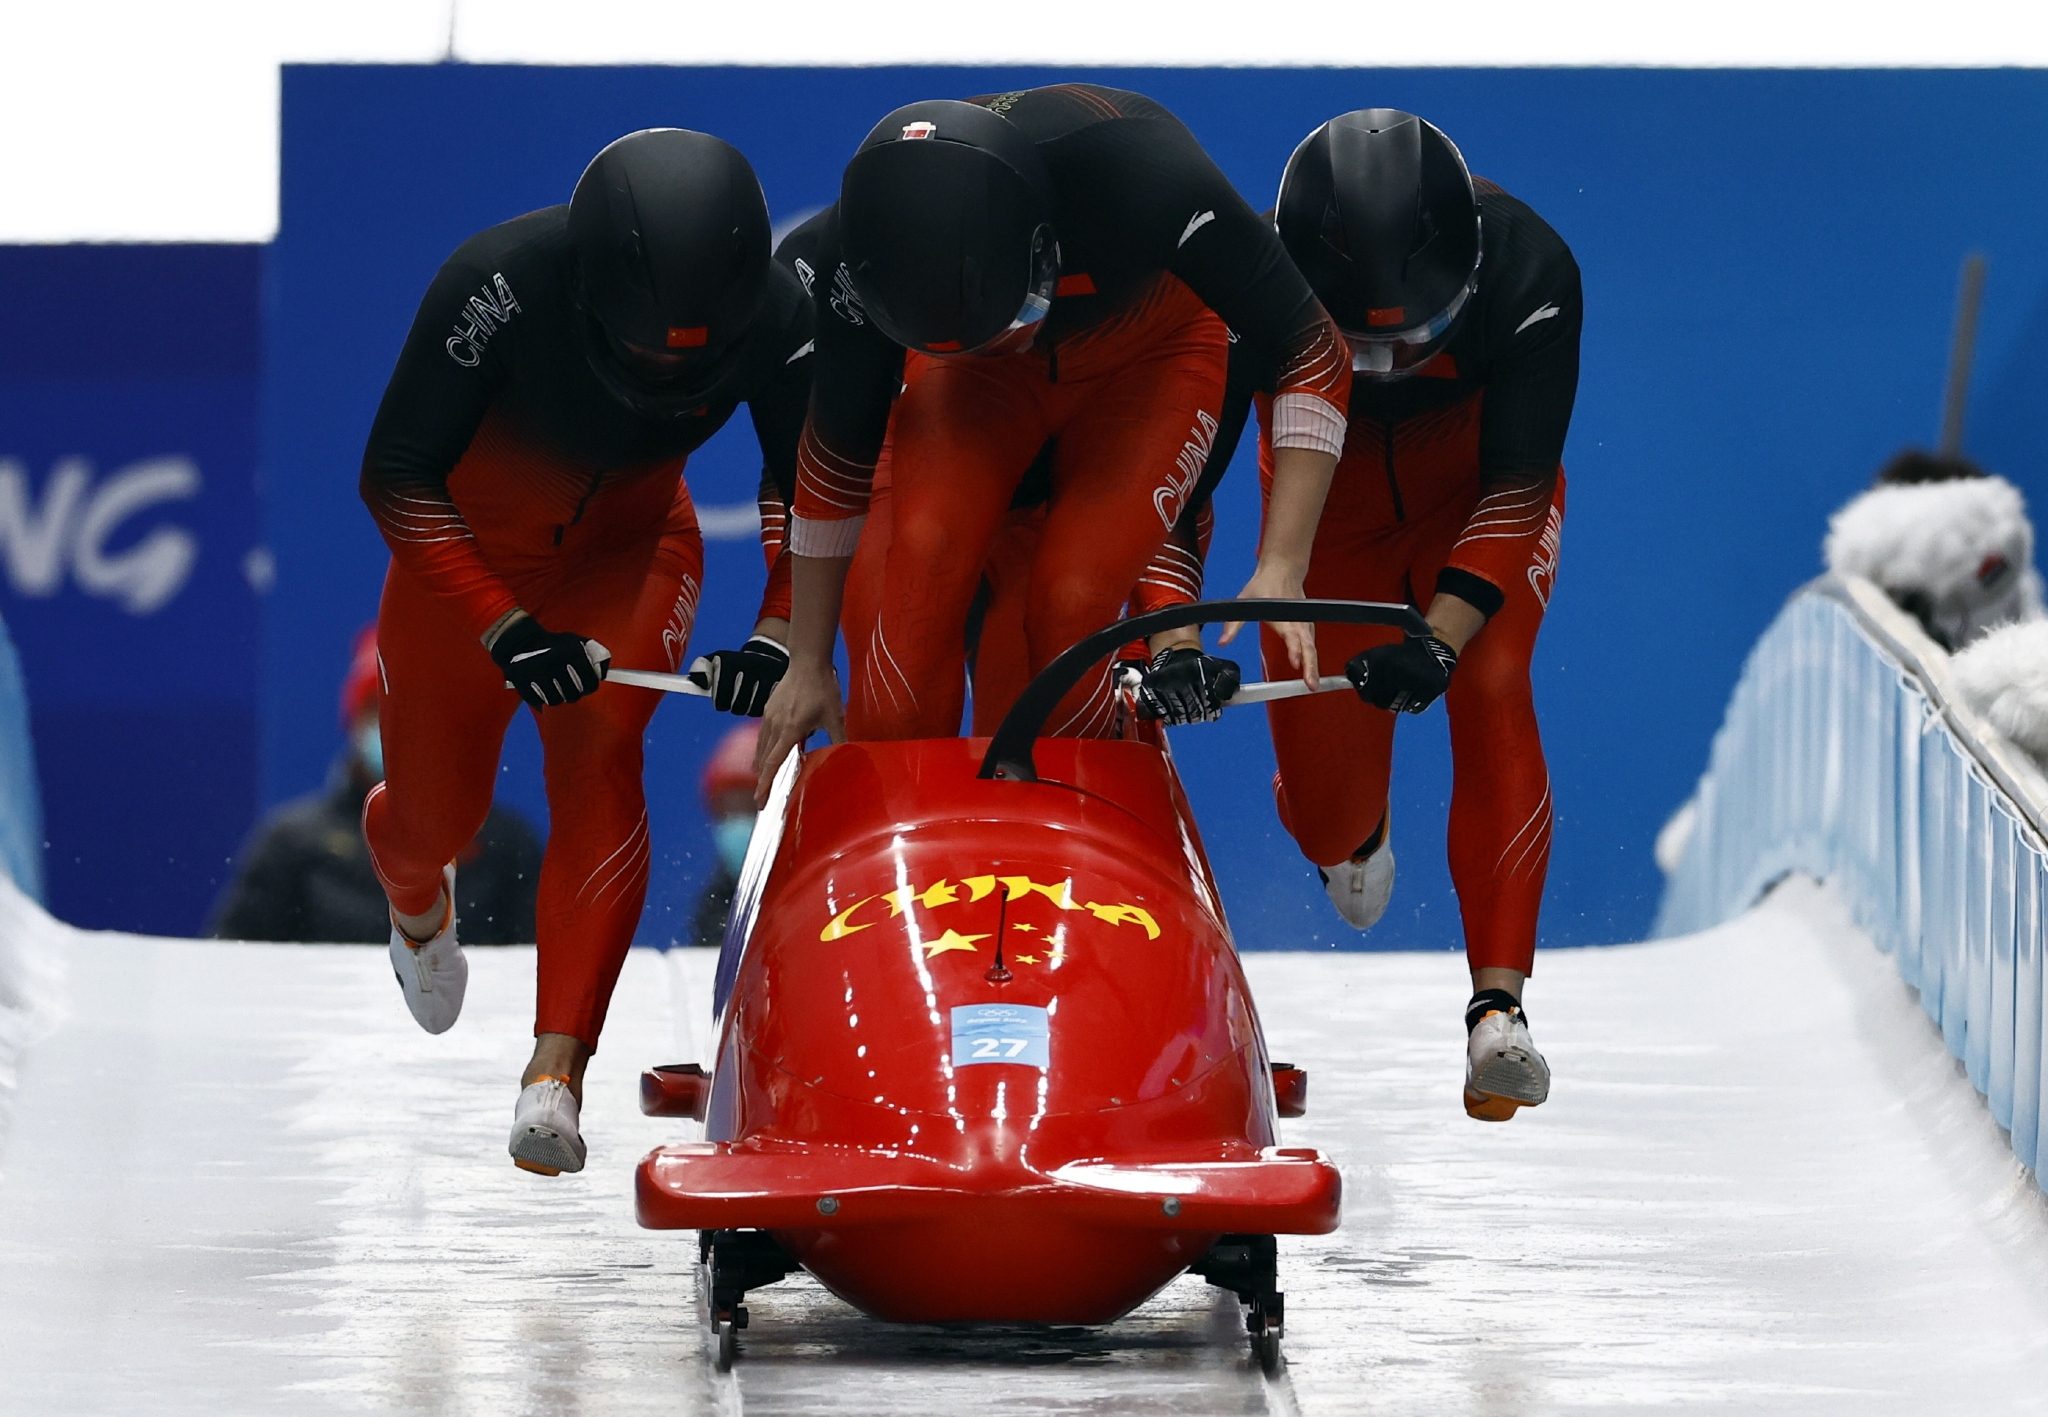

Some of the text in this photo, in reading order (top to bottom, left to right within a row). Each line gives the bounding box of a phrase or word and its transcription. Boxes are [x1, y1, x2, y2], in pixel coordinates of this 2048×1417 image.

[446, 272, 521, 367] CHINA
[1153, 409, 1218, 532] CHINA
[1527, 504, 1561, 611] CHINA
[820, 874, 1161, 941] CHINA
[971, 1038, 1028, 1058] 27
